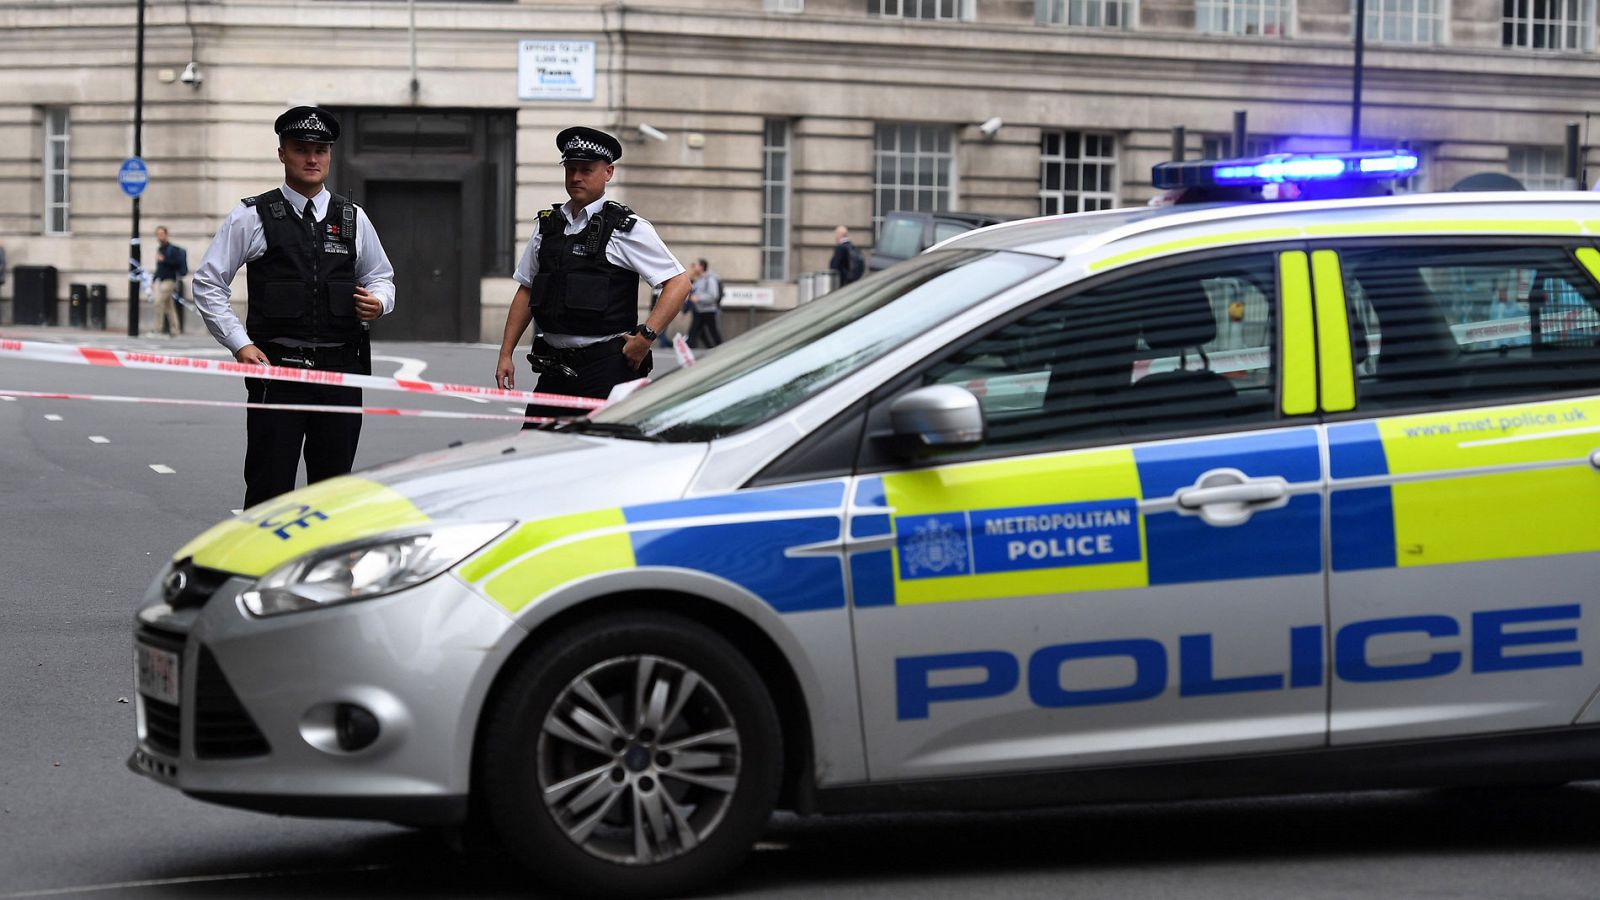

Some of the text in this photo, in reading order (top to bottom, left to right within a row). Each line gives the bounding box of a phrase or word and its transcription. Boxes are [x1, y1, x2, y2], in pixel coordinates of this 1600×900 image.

[125, 352, 164, 365] CROSS
[167, 356, 189, 367] NOT
[192, 359, 208, 369] DO
[306, 371, 343, 384] POLICE
[1405, 407, 1586, 439] www.met.police.uk
[985, 509, 1131, 536] METROPOLITAN
[1008, 534, 1114, 561] POLICE
[895, 603, 1583, 721] POLICE
